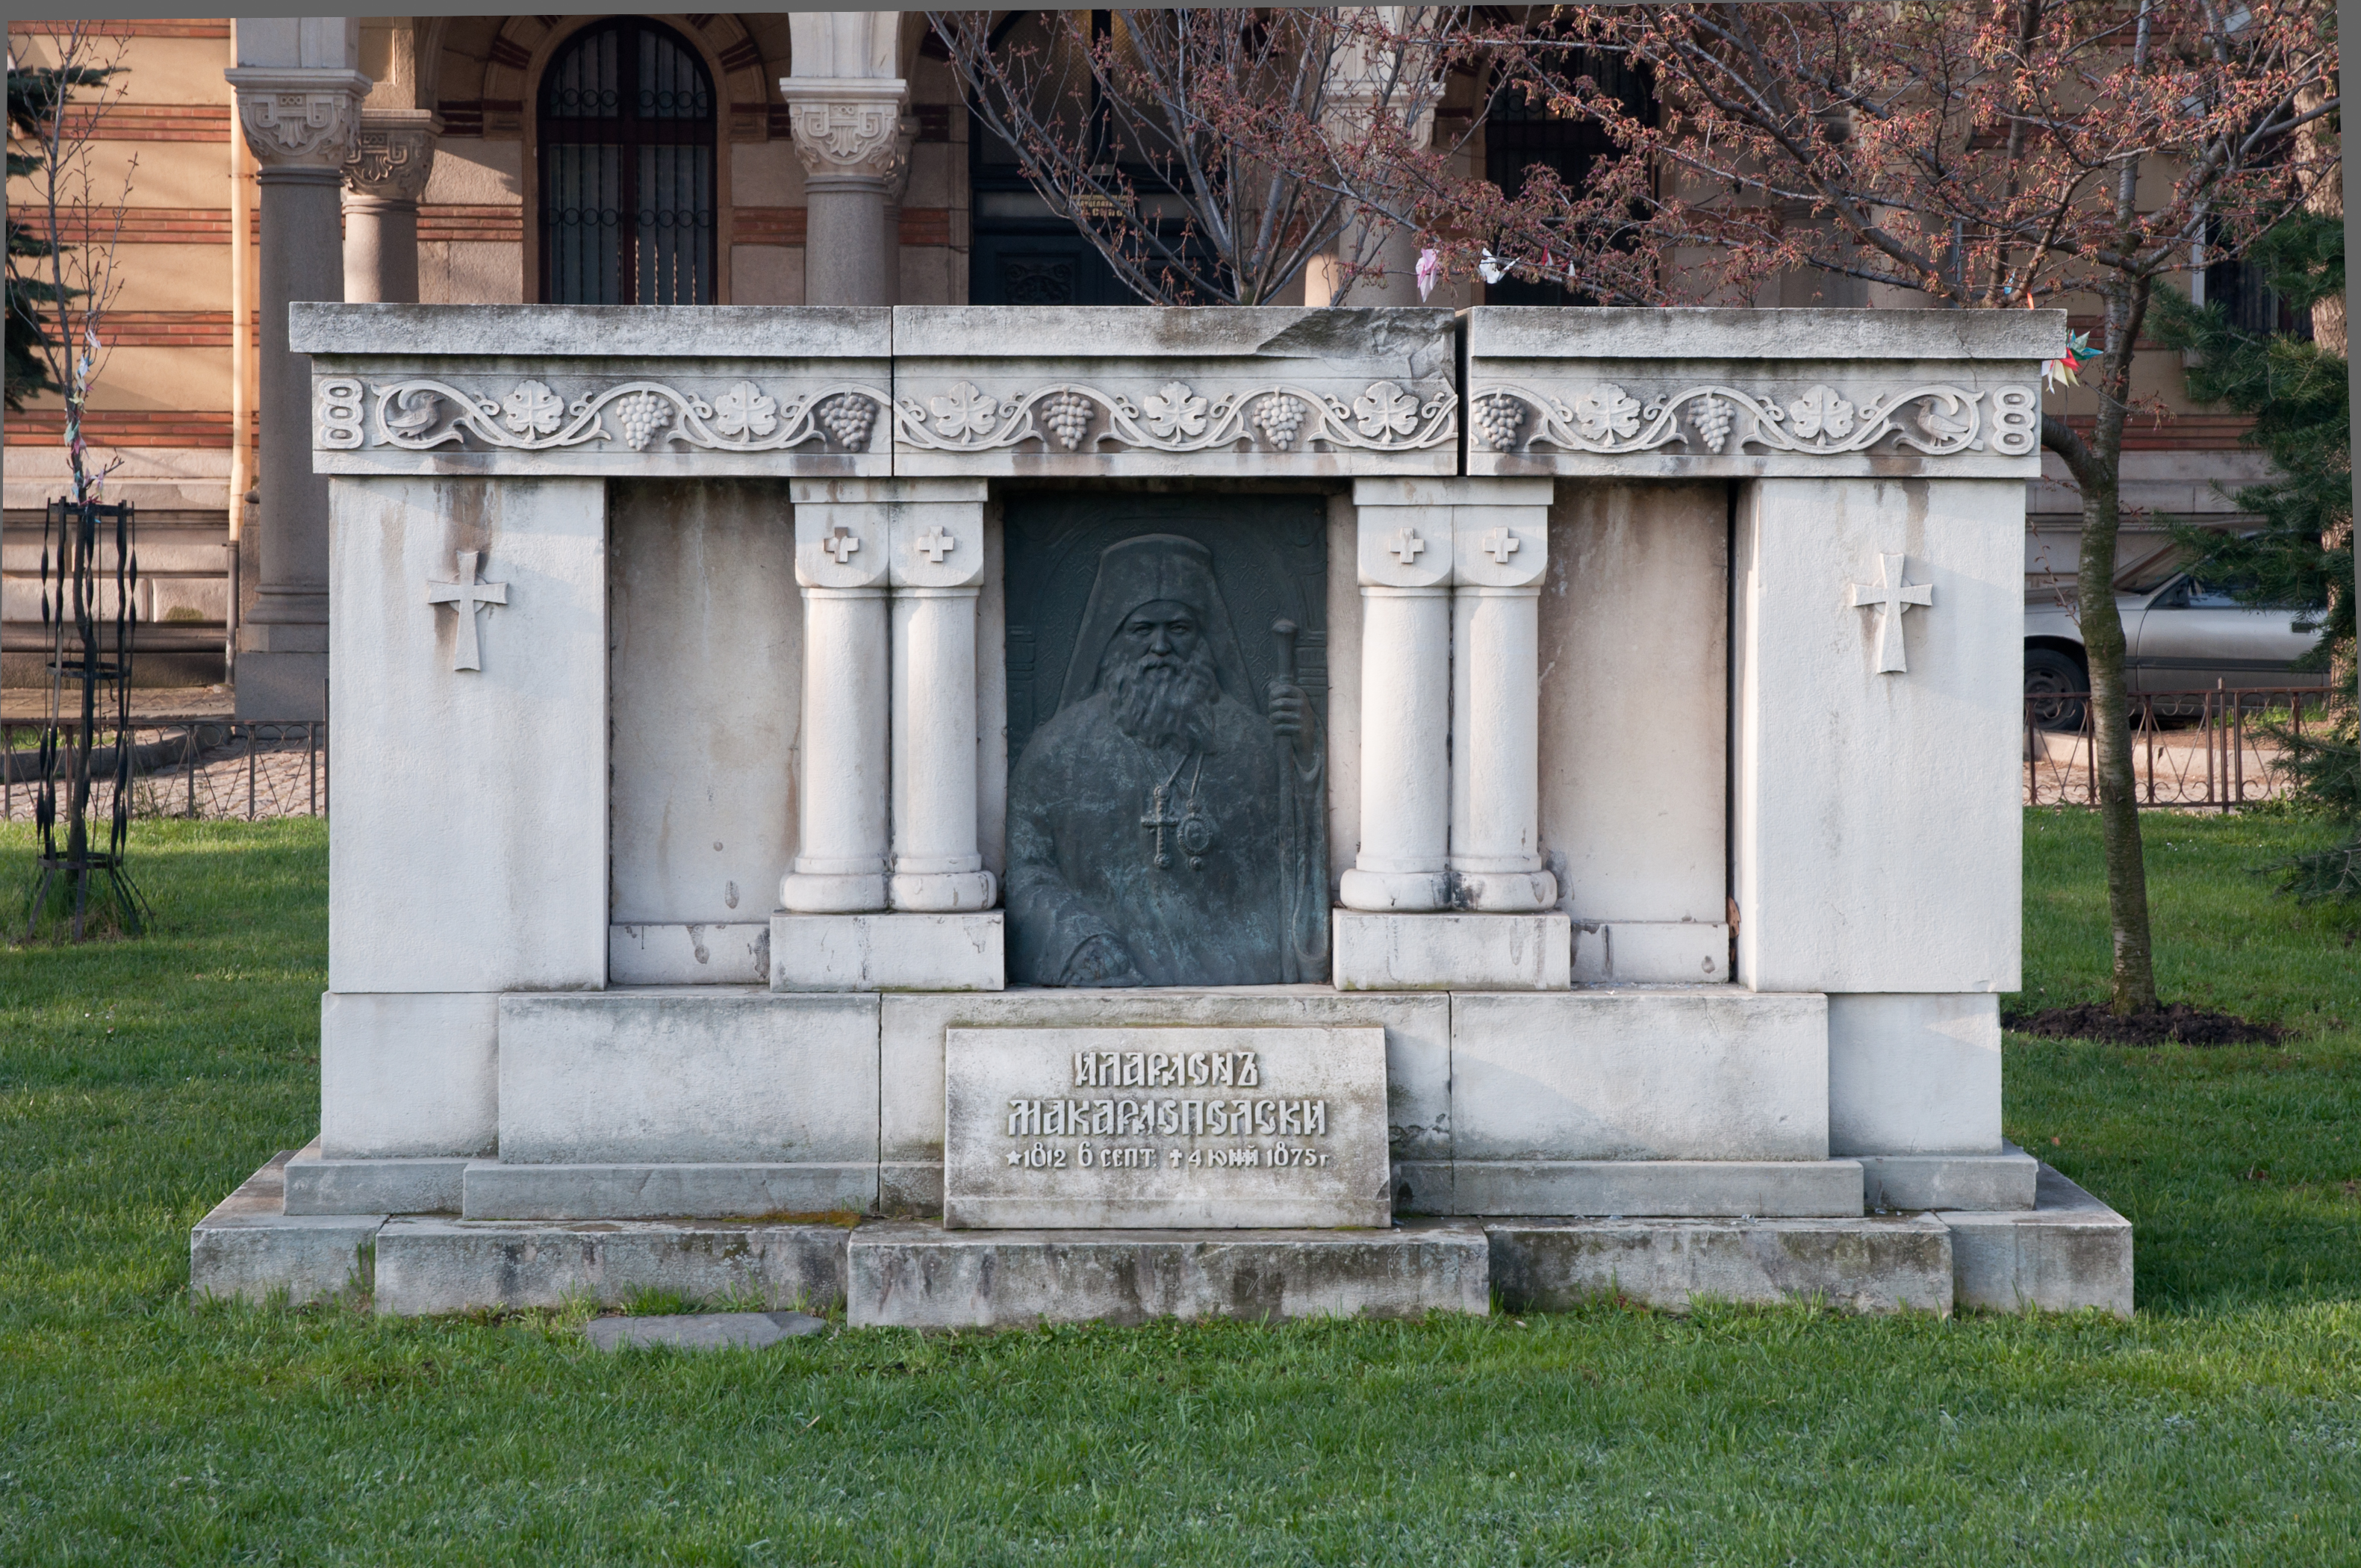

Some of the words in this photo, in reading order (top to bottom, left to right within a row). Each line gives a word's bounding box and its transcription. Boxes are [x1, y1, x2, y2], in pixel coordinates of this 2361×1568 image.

[1008, 1099, 1326, 1135] МАКАРИОПОЛСКИ
[1024, 1141, 1066, 1168] 1812
[1077, 1140, 1093, 1167] 6
[1188, 1148, 1201, 1168] 4
